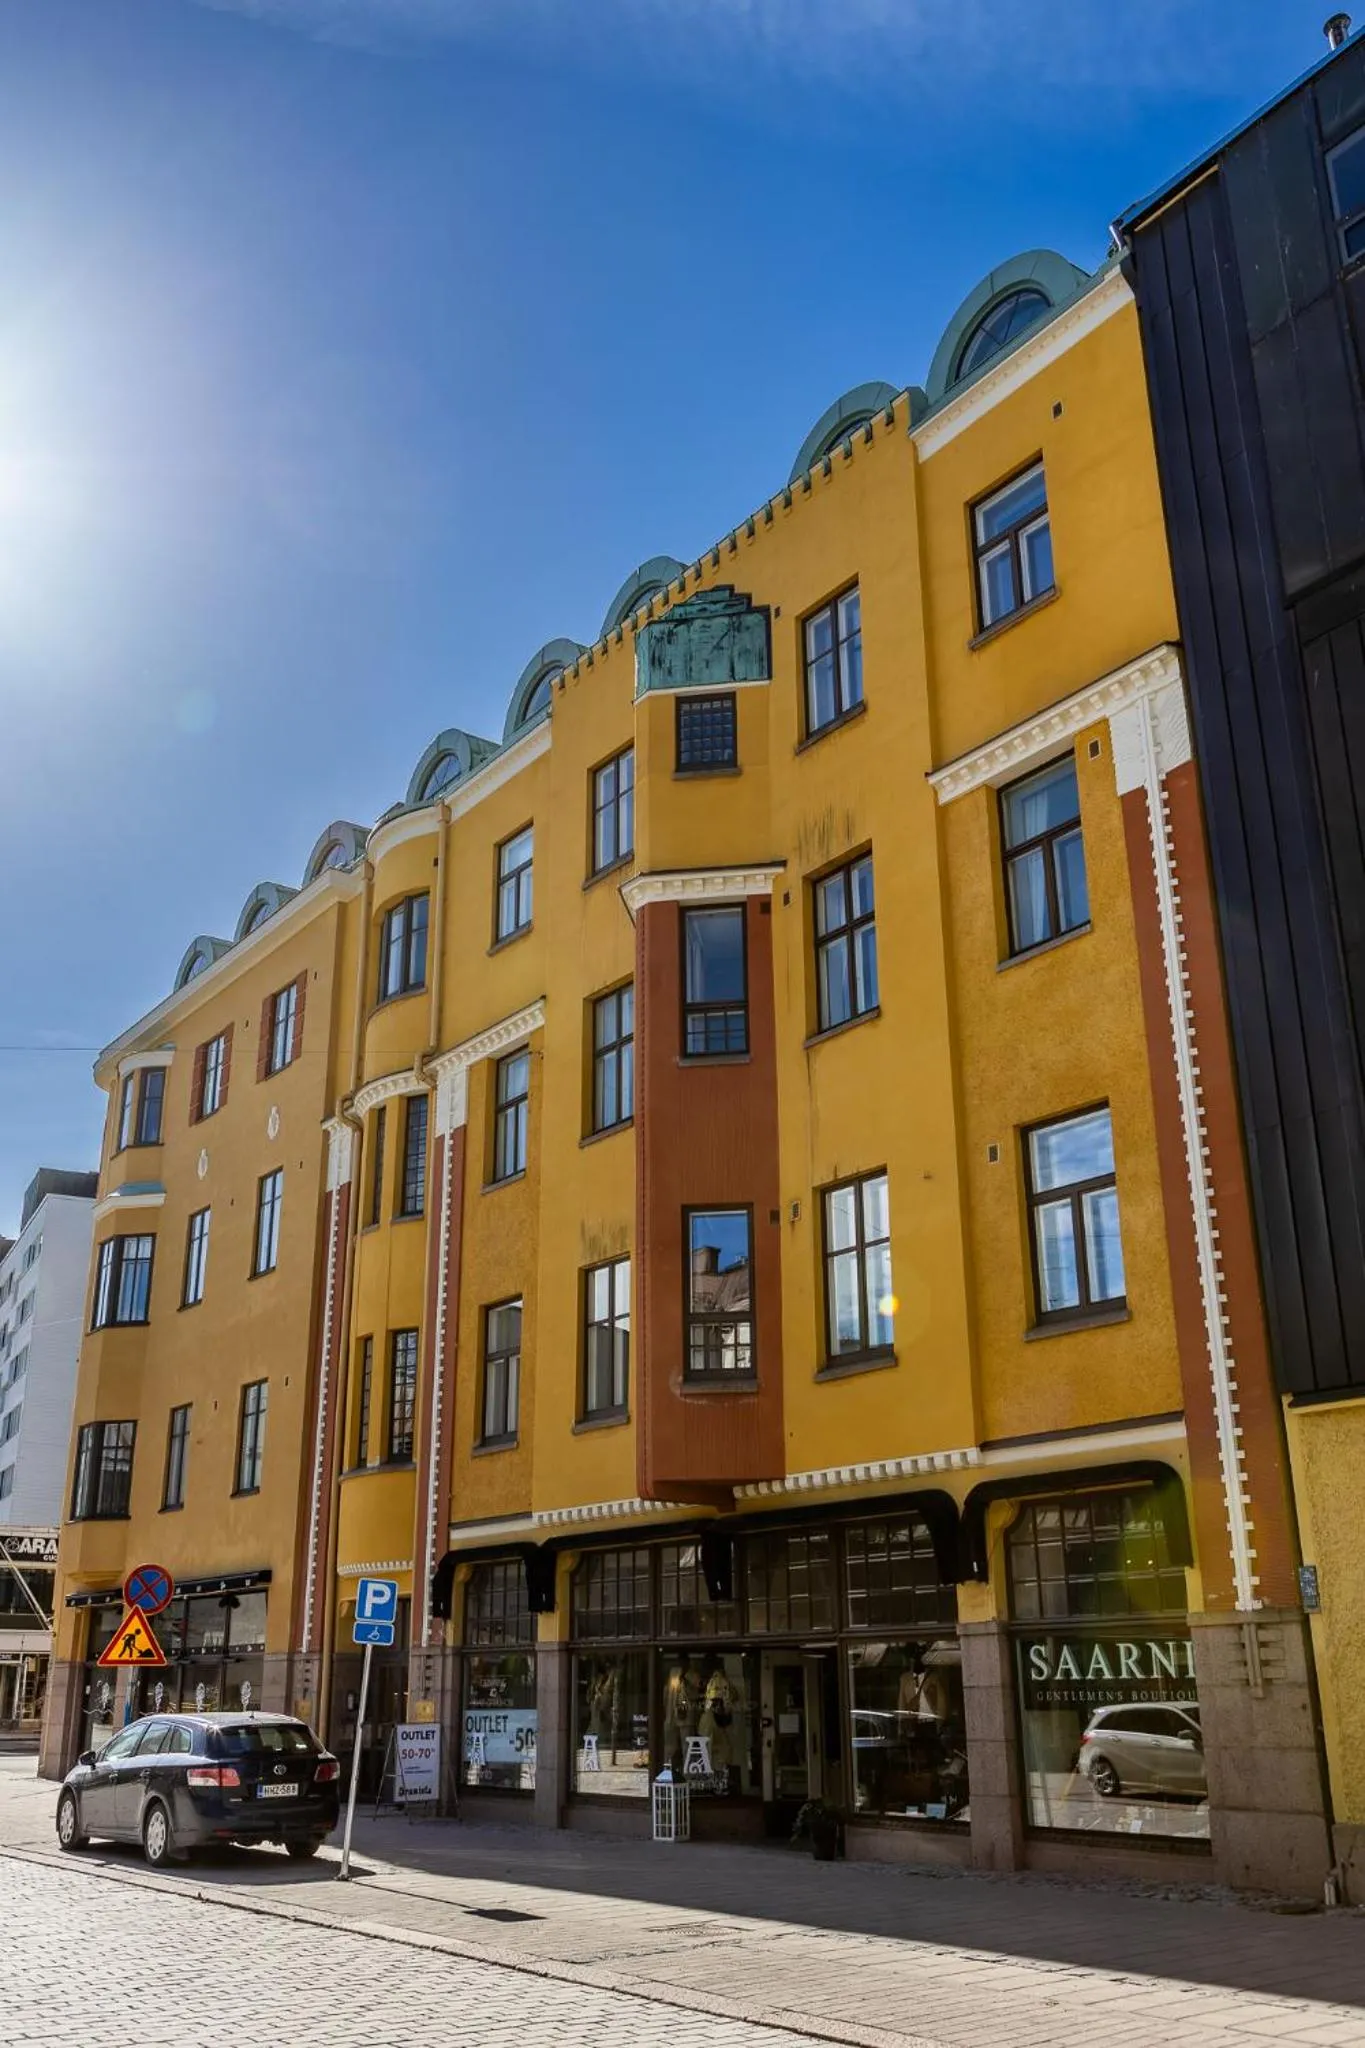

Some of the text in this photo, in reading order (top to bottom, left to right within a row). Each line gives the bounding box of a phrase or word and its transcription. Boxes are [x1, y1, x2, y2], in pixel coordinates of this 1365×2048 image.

[364, 1582, 391, 1617] P
[1029, 1640, 1197, 1681] SAARNI
[401, 1730, 436, 1741] OUTLET
[465, 1715, 509, 1733] OUTLET
